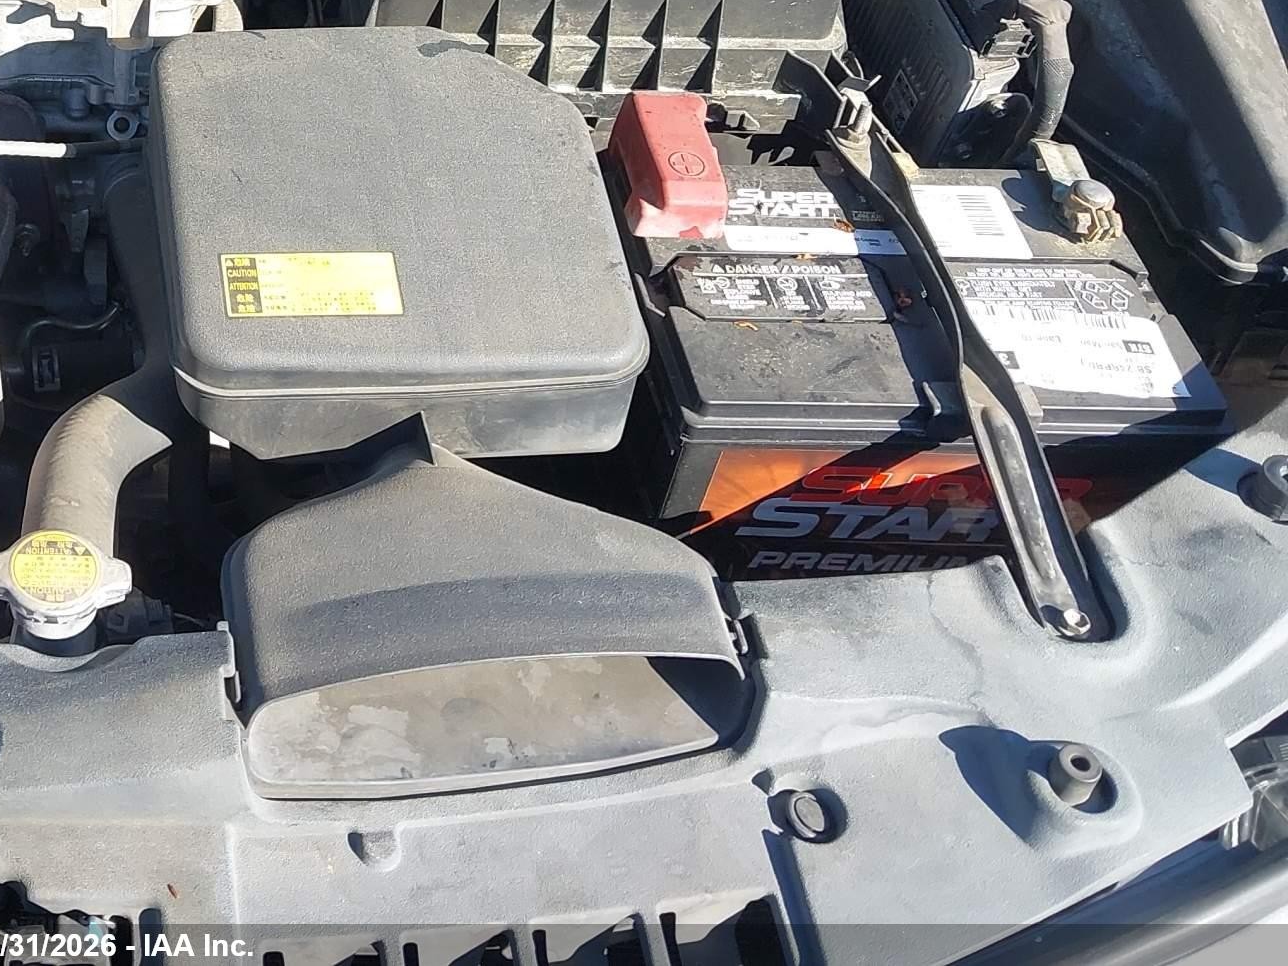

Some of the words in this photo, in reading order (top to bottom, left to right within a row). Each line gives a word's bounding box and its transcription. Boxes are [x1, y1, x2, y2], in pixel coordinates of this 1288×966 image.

[737, 188, 835, 204] SUPER
[728, 199, 841, 218] START
[227, 269, 257, 278] CAUTION
[725, 264, 779, 274] DANGER
[791, 264, 842, 274] POISON
